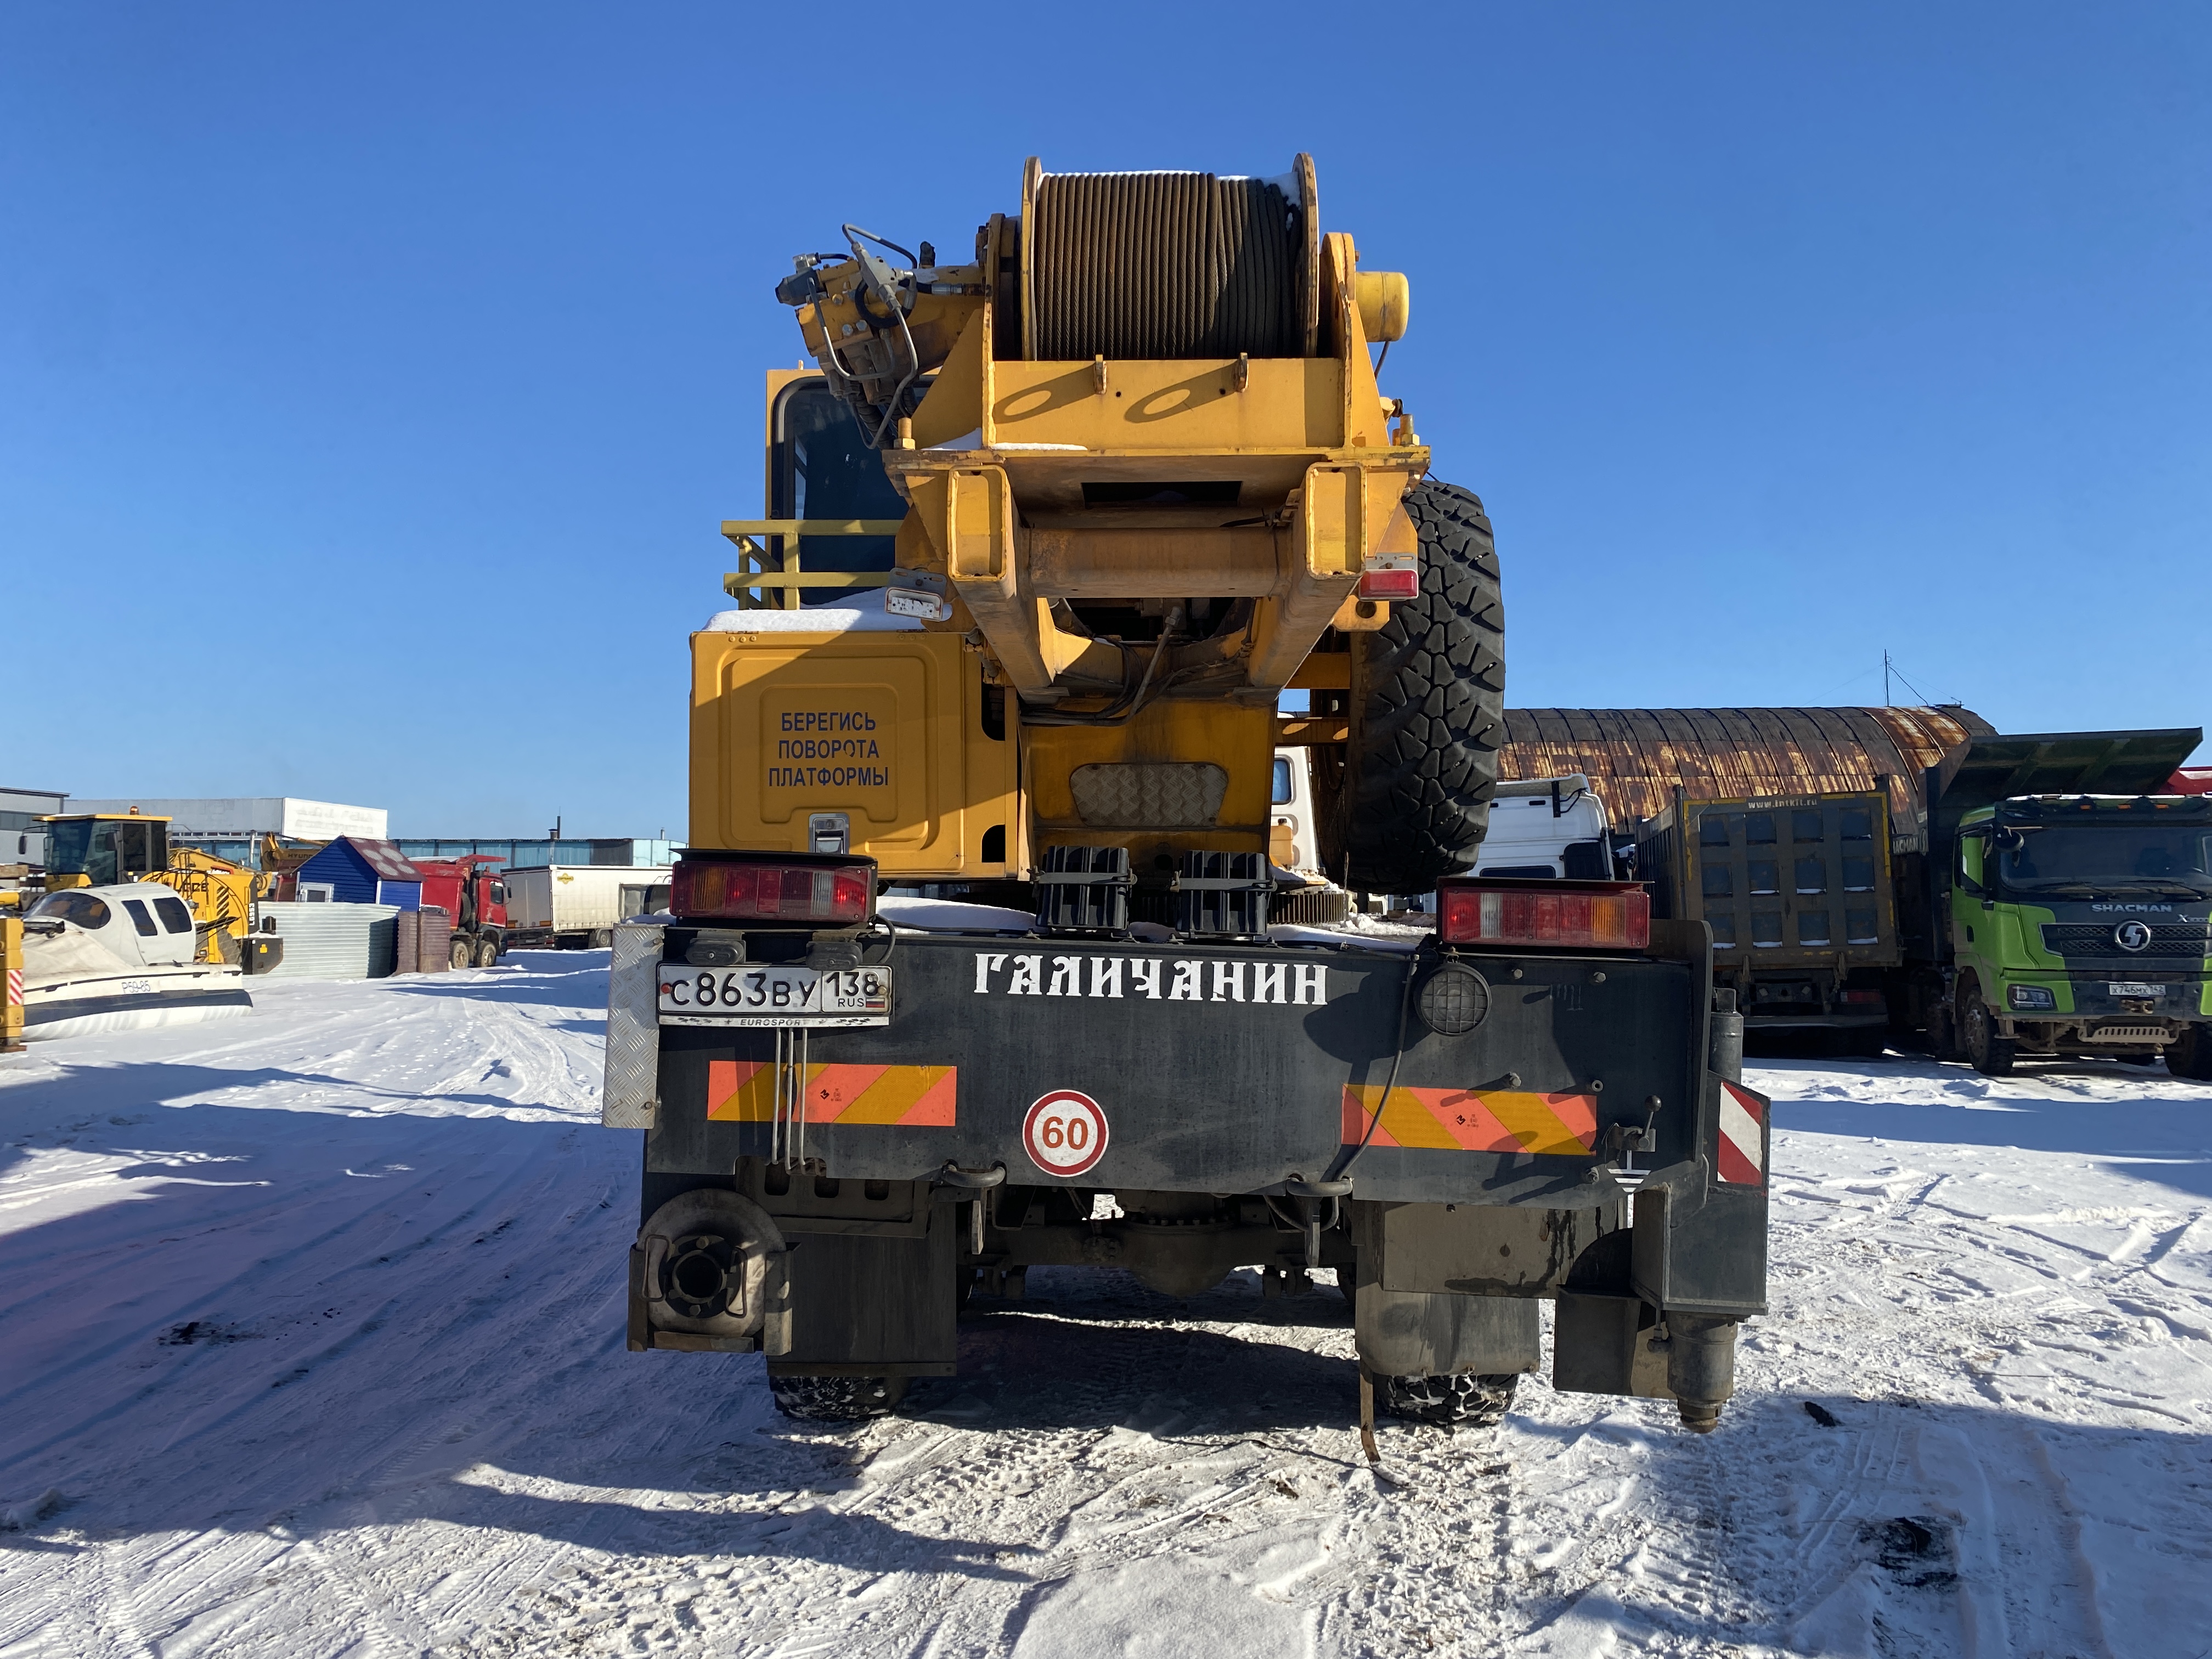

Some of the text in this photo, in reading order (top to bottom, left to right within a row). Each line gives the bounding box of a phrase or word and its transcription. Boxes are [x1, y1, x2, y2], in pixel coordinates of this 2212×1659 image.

[781, 712, 876, 731] БЕРЕГИСЬ
[778, 739, 879, 759] ПОВОРОТА
[769, 767, 888, 787] ПЛАТФОРМЫ
[2091, 904, 2172, 913] SHACMAN
[826, 972, 879, 997] 138
[974, 953, 1329, 1006] ГАЛИЧАНИН
[837, 997, 865, 1008] RUS
[1042, 1116, 1088, 1150] 60
